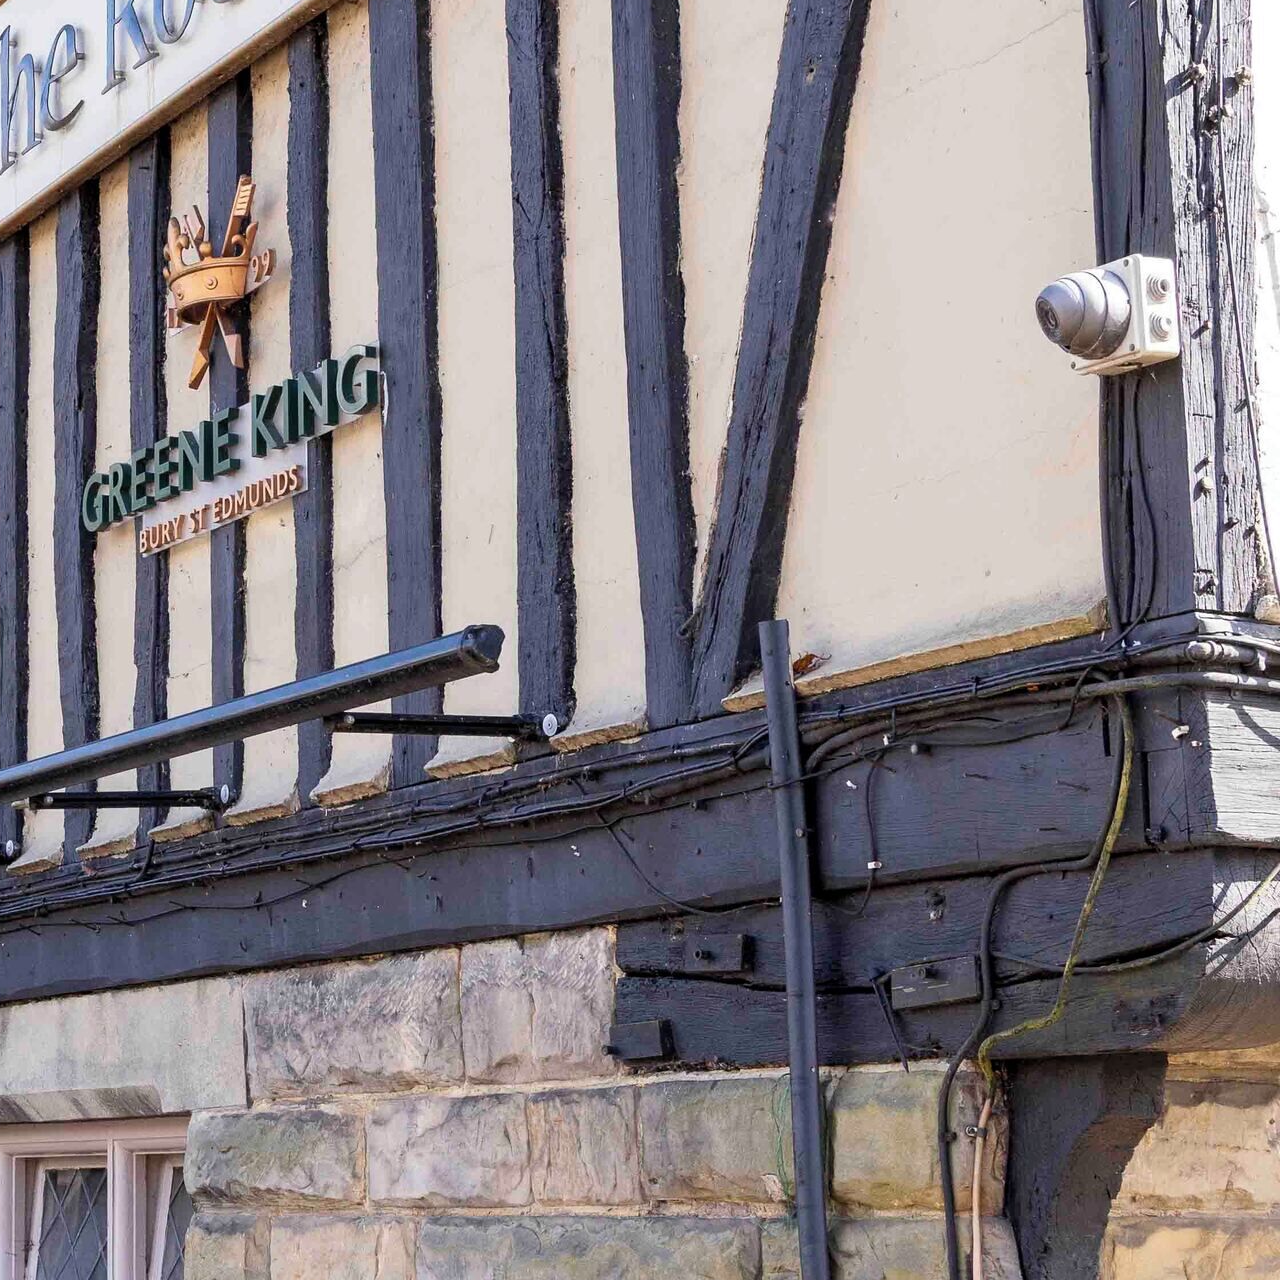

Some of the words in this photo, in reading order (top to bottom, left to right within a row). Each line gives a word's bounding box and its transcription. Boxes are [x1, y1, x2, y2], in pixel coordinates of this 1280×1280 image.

[81, 407, 241, 532] GREENE
[251, 344, 379, 458] KING
[139, 513, 185, 553] BURY
[188, 505, 208, 533] ST
[213, 464, 300, 523] EDMUNDS
